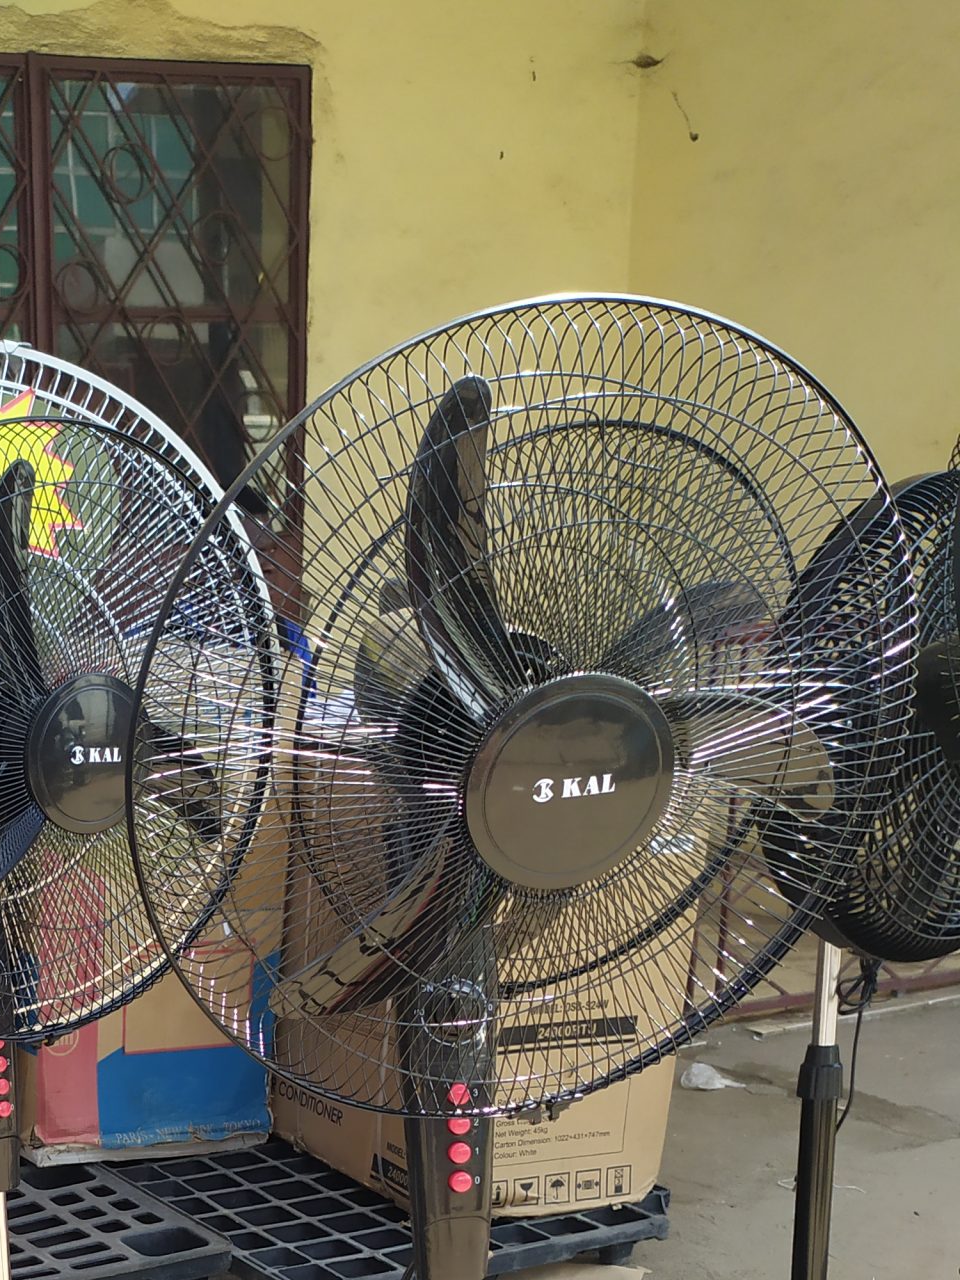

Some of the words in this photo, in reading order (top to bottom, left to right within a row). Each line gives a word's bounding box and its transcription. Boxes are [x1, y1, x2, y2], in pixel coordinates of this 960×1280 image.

[88, 747, 122, 763] KAL
[561, 773, 616, 799] KAL
[278, 1080, 344, 1127] CONDITIONER
[387, 1165, 409, 1187] 24000
